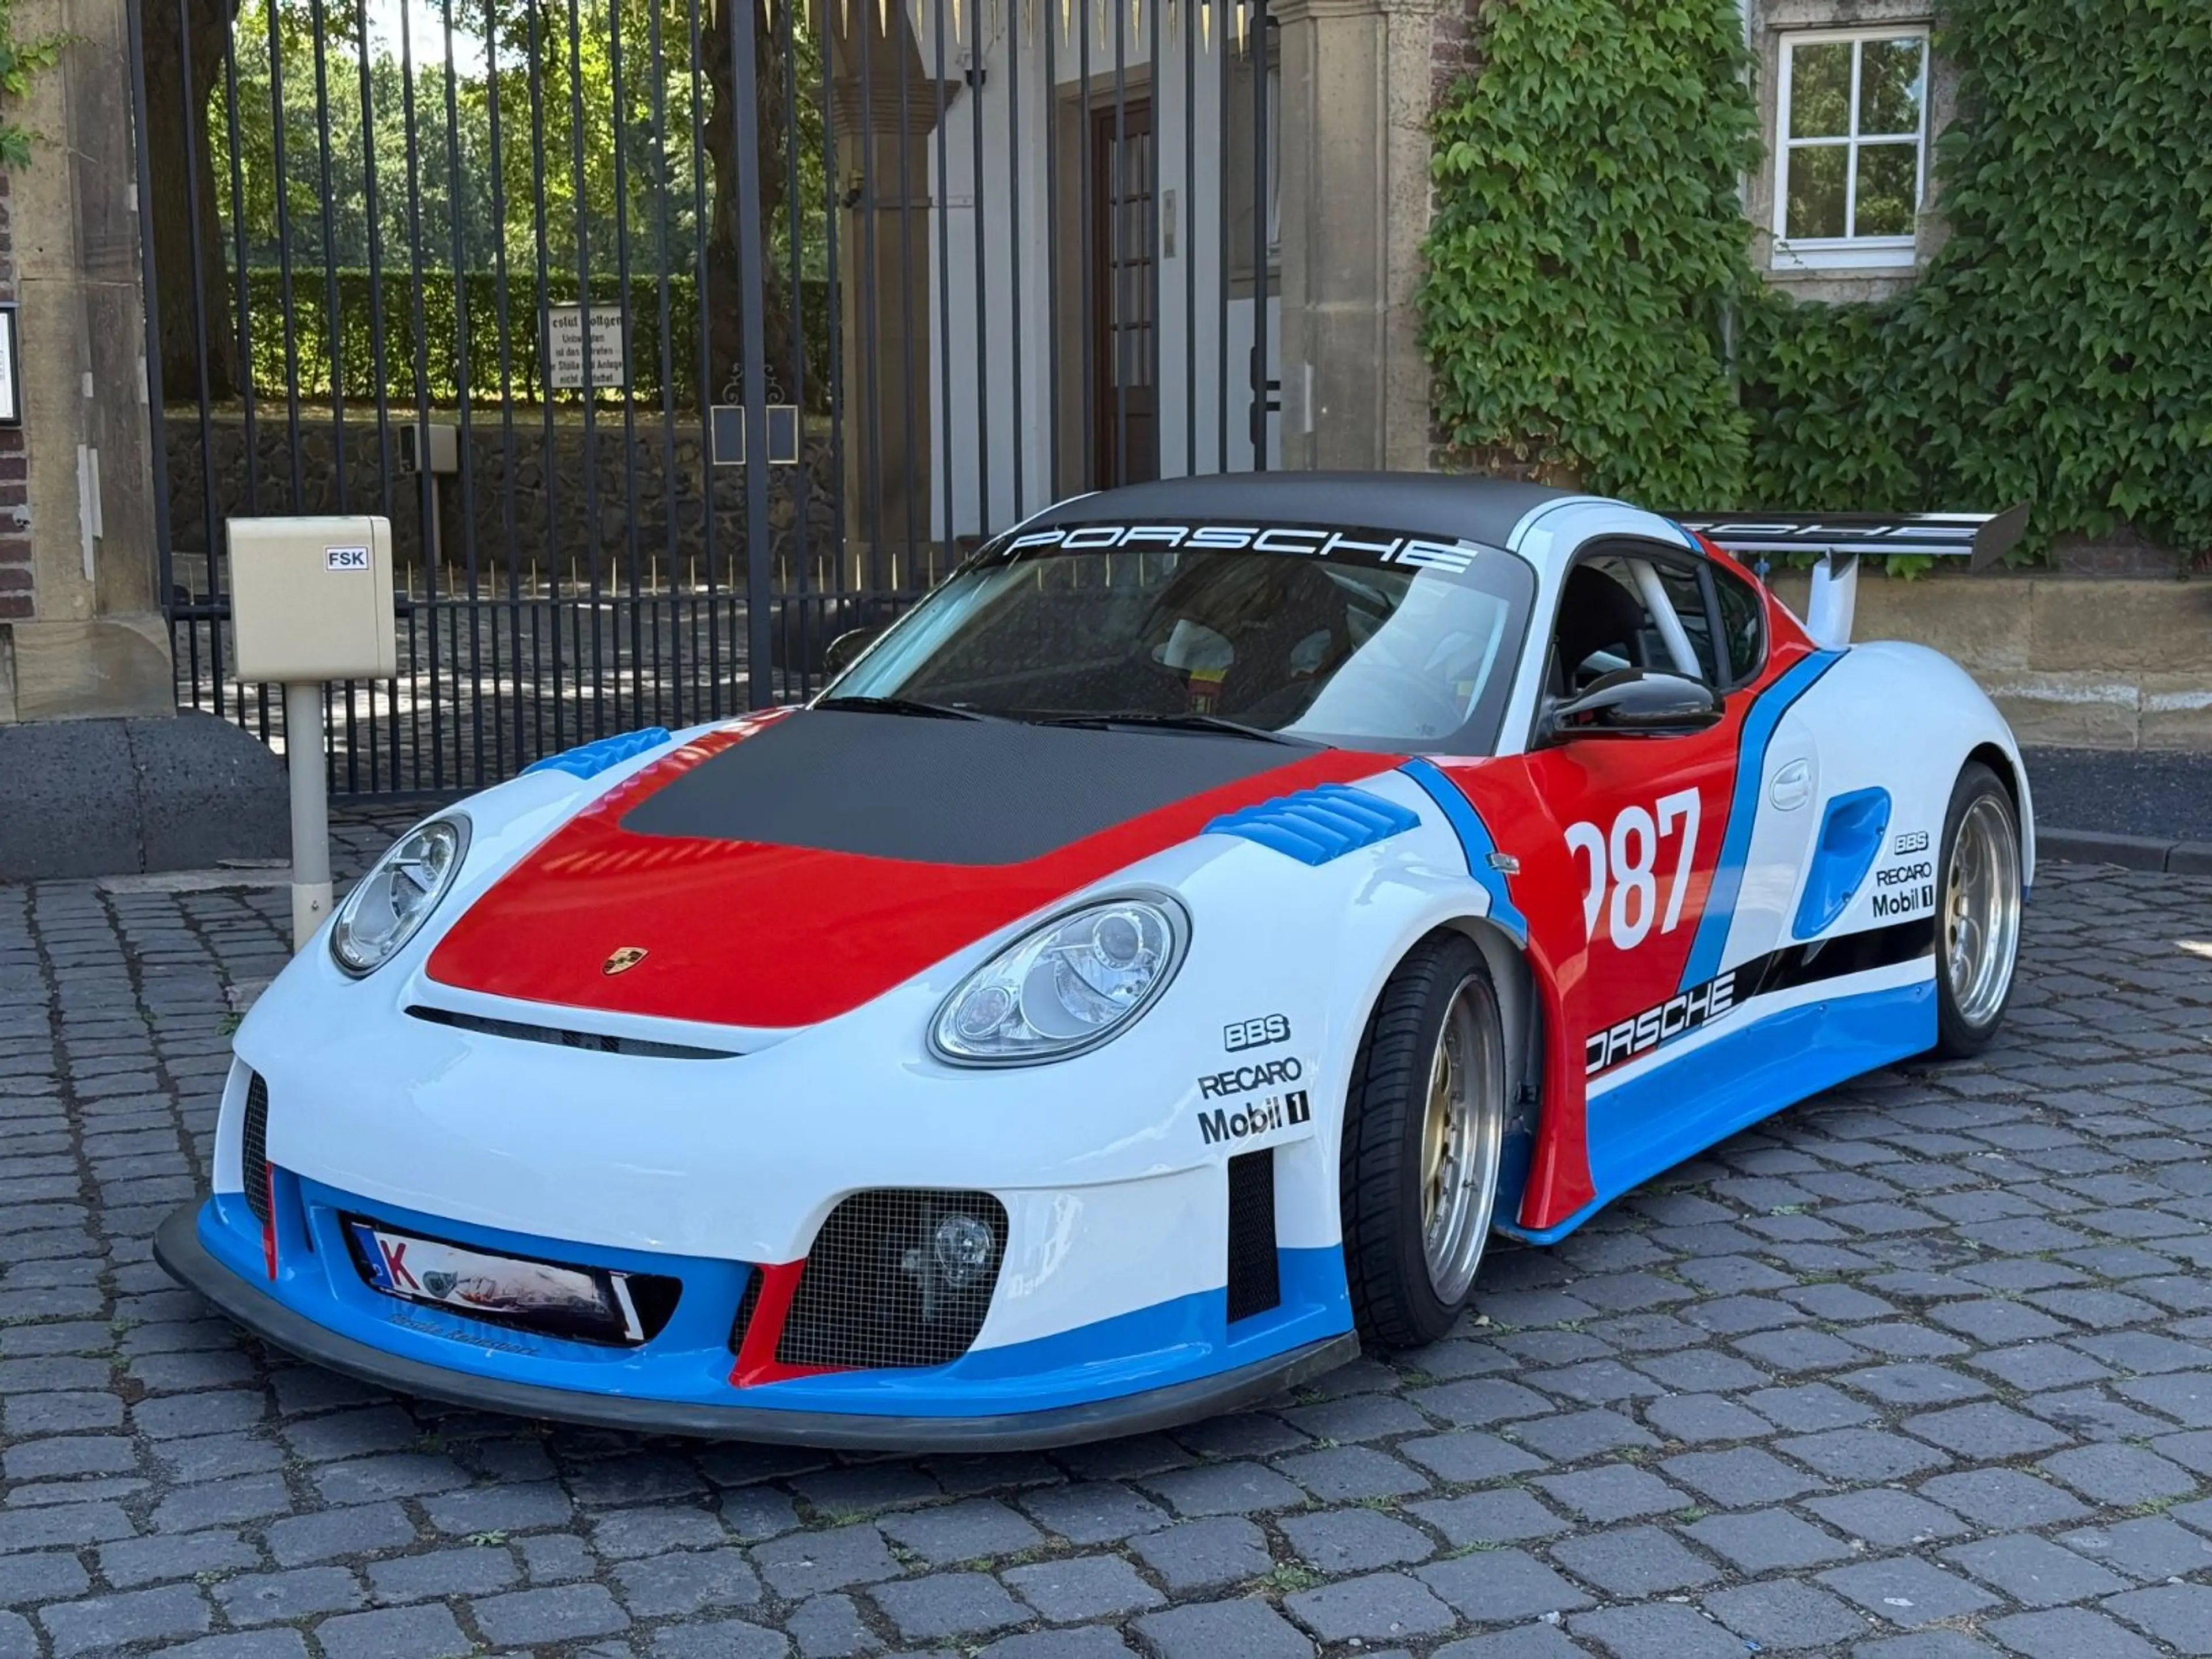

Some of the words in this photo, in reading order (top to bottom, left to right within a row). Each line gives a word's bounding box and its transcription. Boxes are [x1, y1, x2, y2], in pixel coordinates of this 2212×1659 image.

[597, 359, 622, 371] Anlage
[329, 552, 365, 566] FSK
[1002, 525, 1479, 574] PORSCHE
[1895, 831, 1929, 855] BBS
[1876, 861, 1932, 887] RECARO
[1872, 888, 1919, 918] Mobil
[1224, 1013, 1291, 1052] BBS
[1586, 972, 1736, 1075] ORSCHE
[1197, 1056, 1302, 1100] RECARO
[1197, 1096, 1282, 1145] Mobil
[380, 1240, 420, 1290] K
